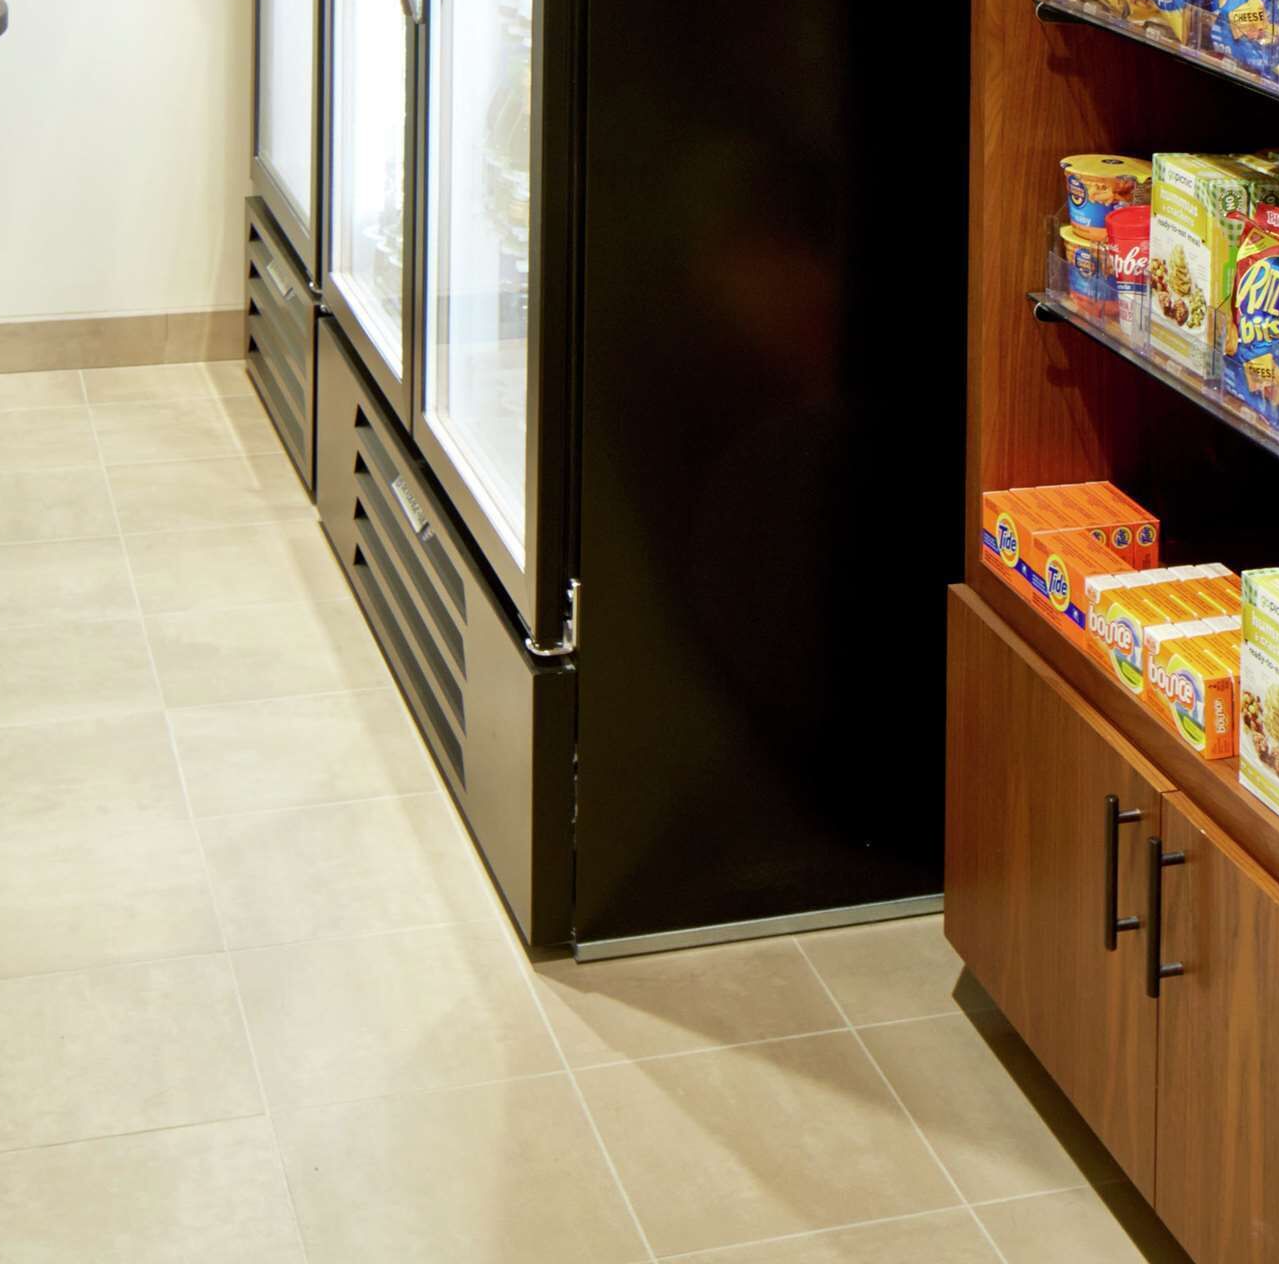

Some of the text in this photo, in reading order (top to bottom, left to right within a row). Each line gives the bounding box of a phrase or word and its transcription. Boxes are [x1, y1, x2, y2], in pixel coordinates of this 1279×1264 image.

[1233, 10, 1265, 22] CHEESE
[998, 524, 1018, 553] Tide
[1047, 566, 1068, 596] Tide
[1088, 603, 1133, 651] bounce
[1148, 654, 1193, 705] bounce
